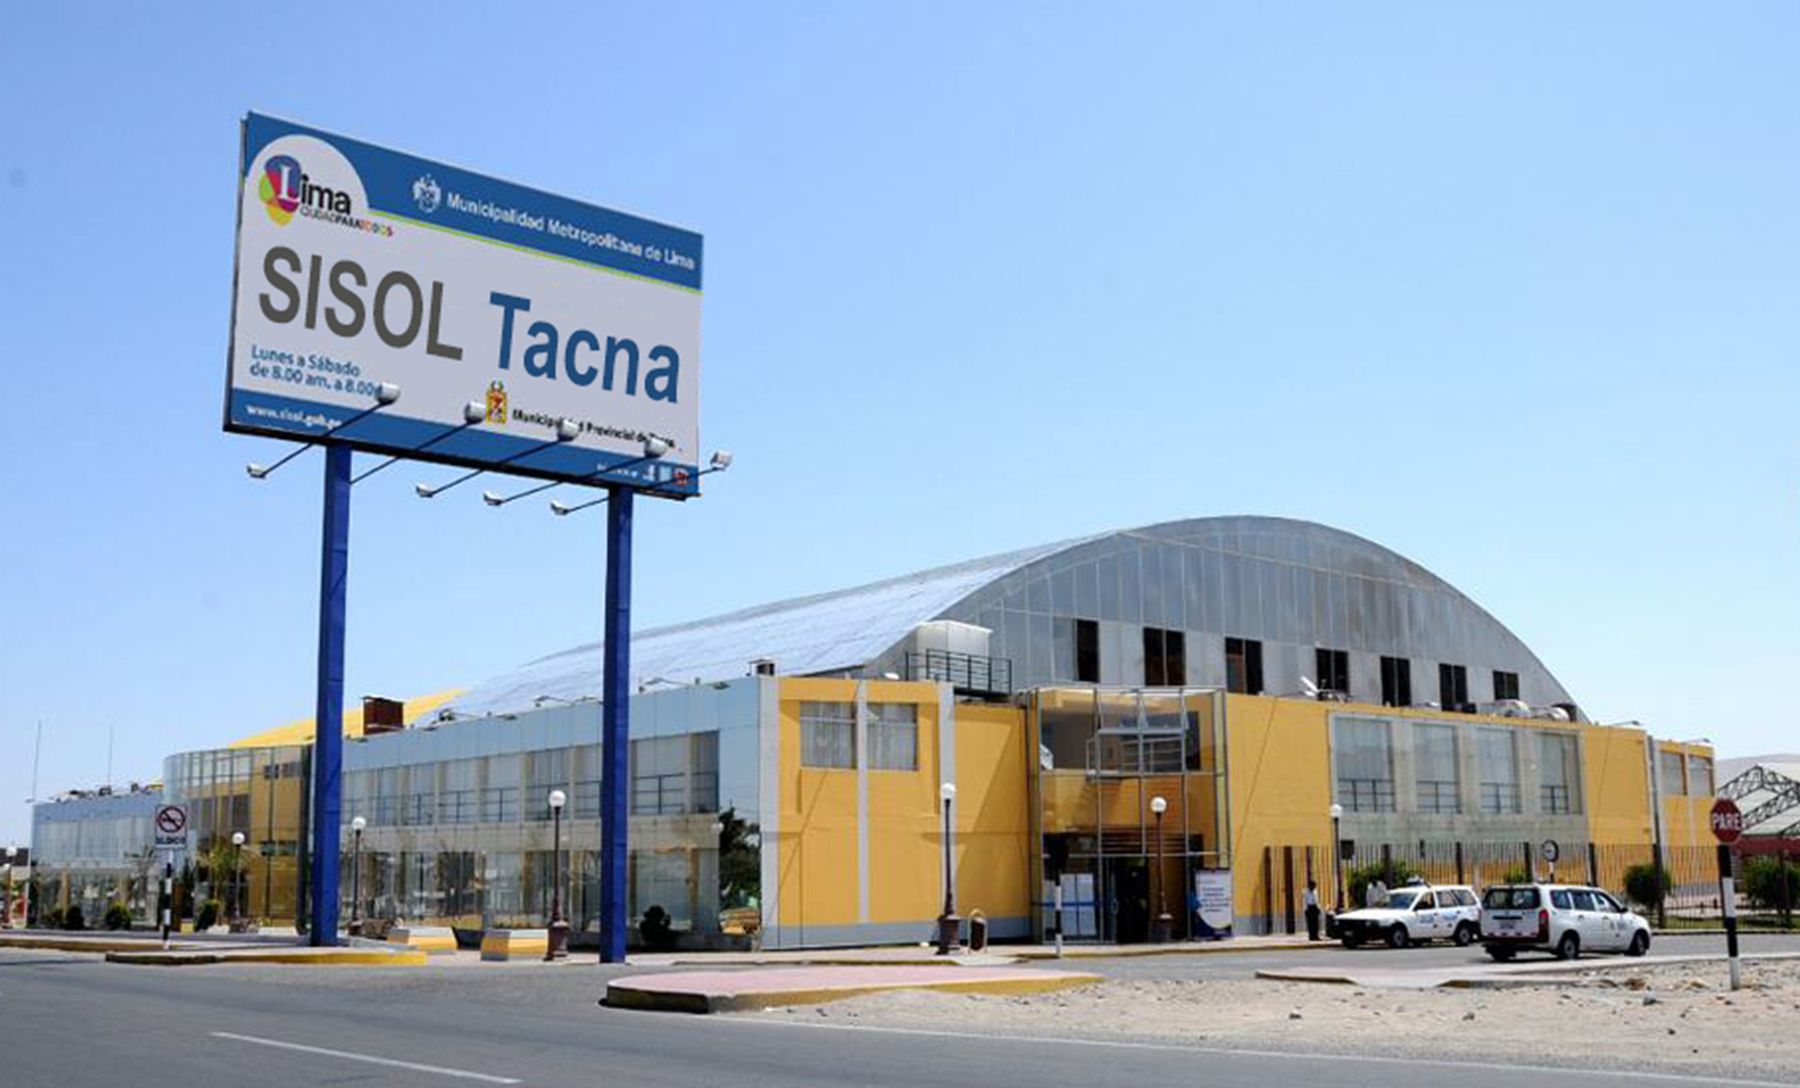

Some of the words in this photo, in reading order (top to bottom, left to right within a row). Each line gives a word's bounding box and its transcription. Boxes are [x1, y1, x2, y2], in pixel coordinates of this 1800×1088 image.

[278, 164, 351, 216] Lima
[447, 192, 544, 231] Municipalidad
[548, 219, 643, 257] Metropolitana
[645, 244, 662, 263] de
[664, 249, 695, 270] Lima
[259, 246, 464, 361] SISOL
[490, 291, 679, 404] Tacna
[250, 362, 270, 378] de
[272, 367, 303, 383] 8.00
[334, 380, 343, 391] a
[251, 344, 294, 366] Lunes
[297, 355, 306, 367] a
[308, 353, 361, 378] Sábado
[586, 421, 636, 441] Provincial
[1712, 812, 1741, 830] PARE
